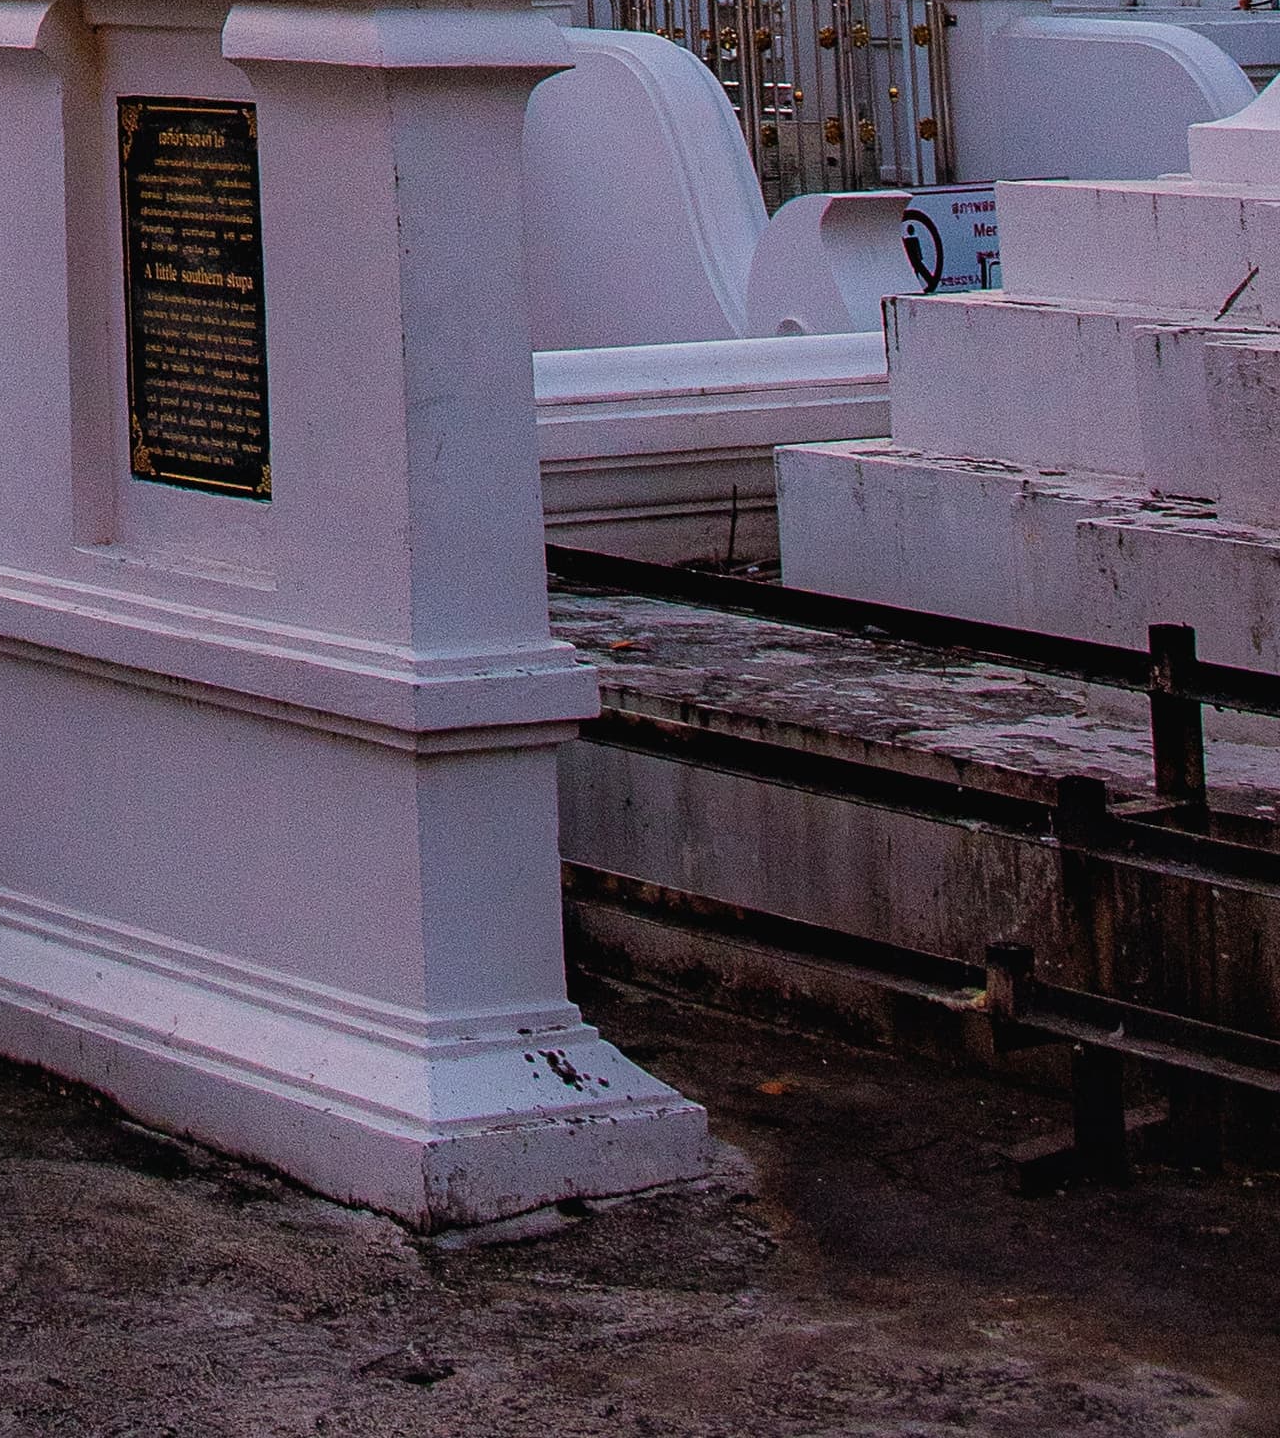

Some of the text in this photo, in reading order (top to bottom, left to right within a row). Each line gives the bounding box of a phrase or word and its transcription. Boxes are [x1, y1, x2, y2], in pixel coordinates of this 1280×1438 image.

[144, 262, 253, 294] A little southern stupa
